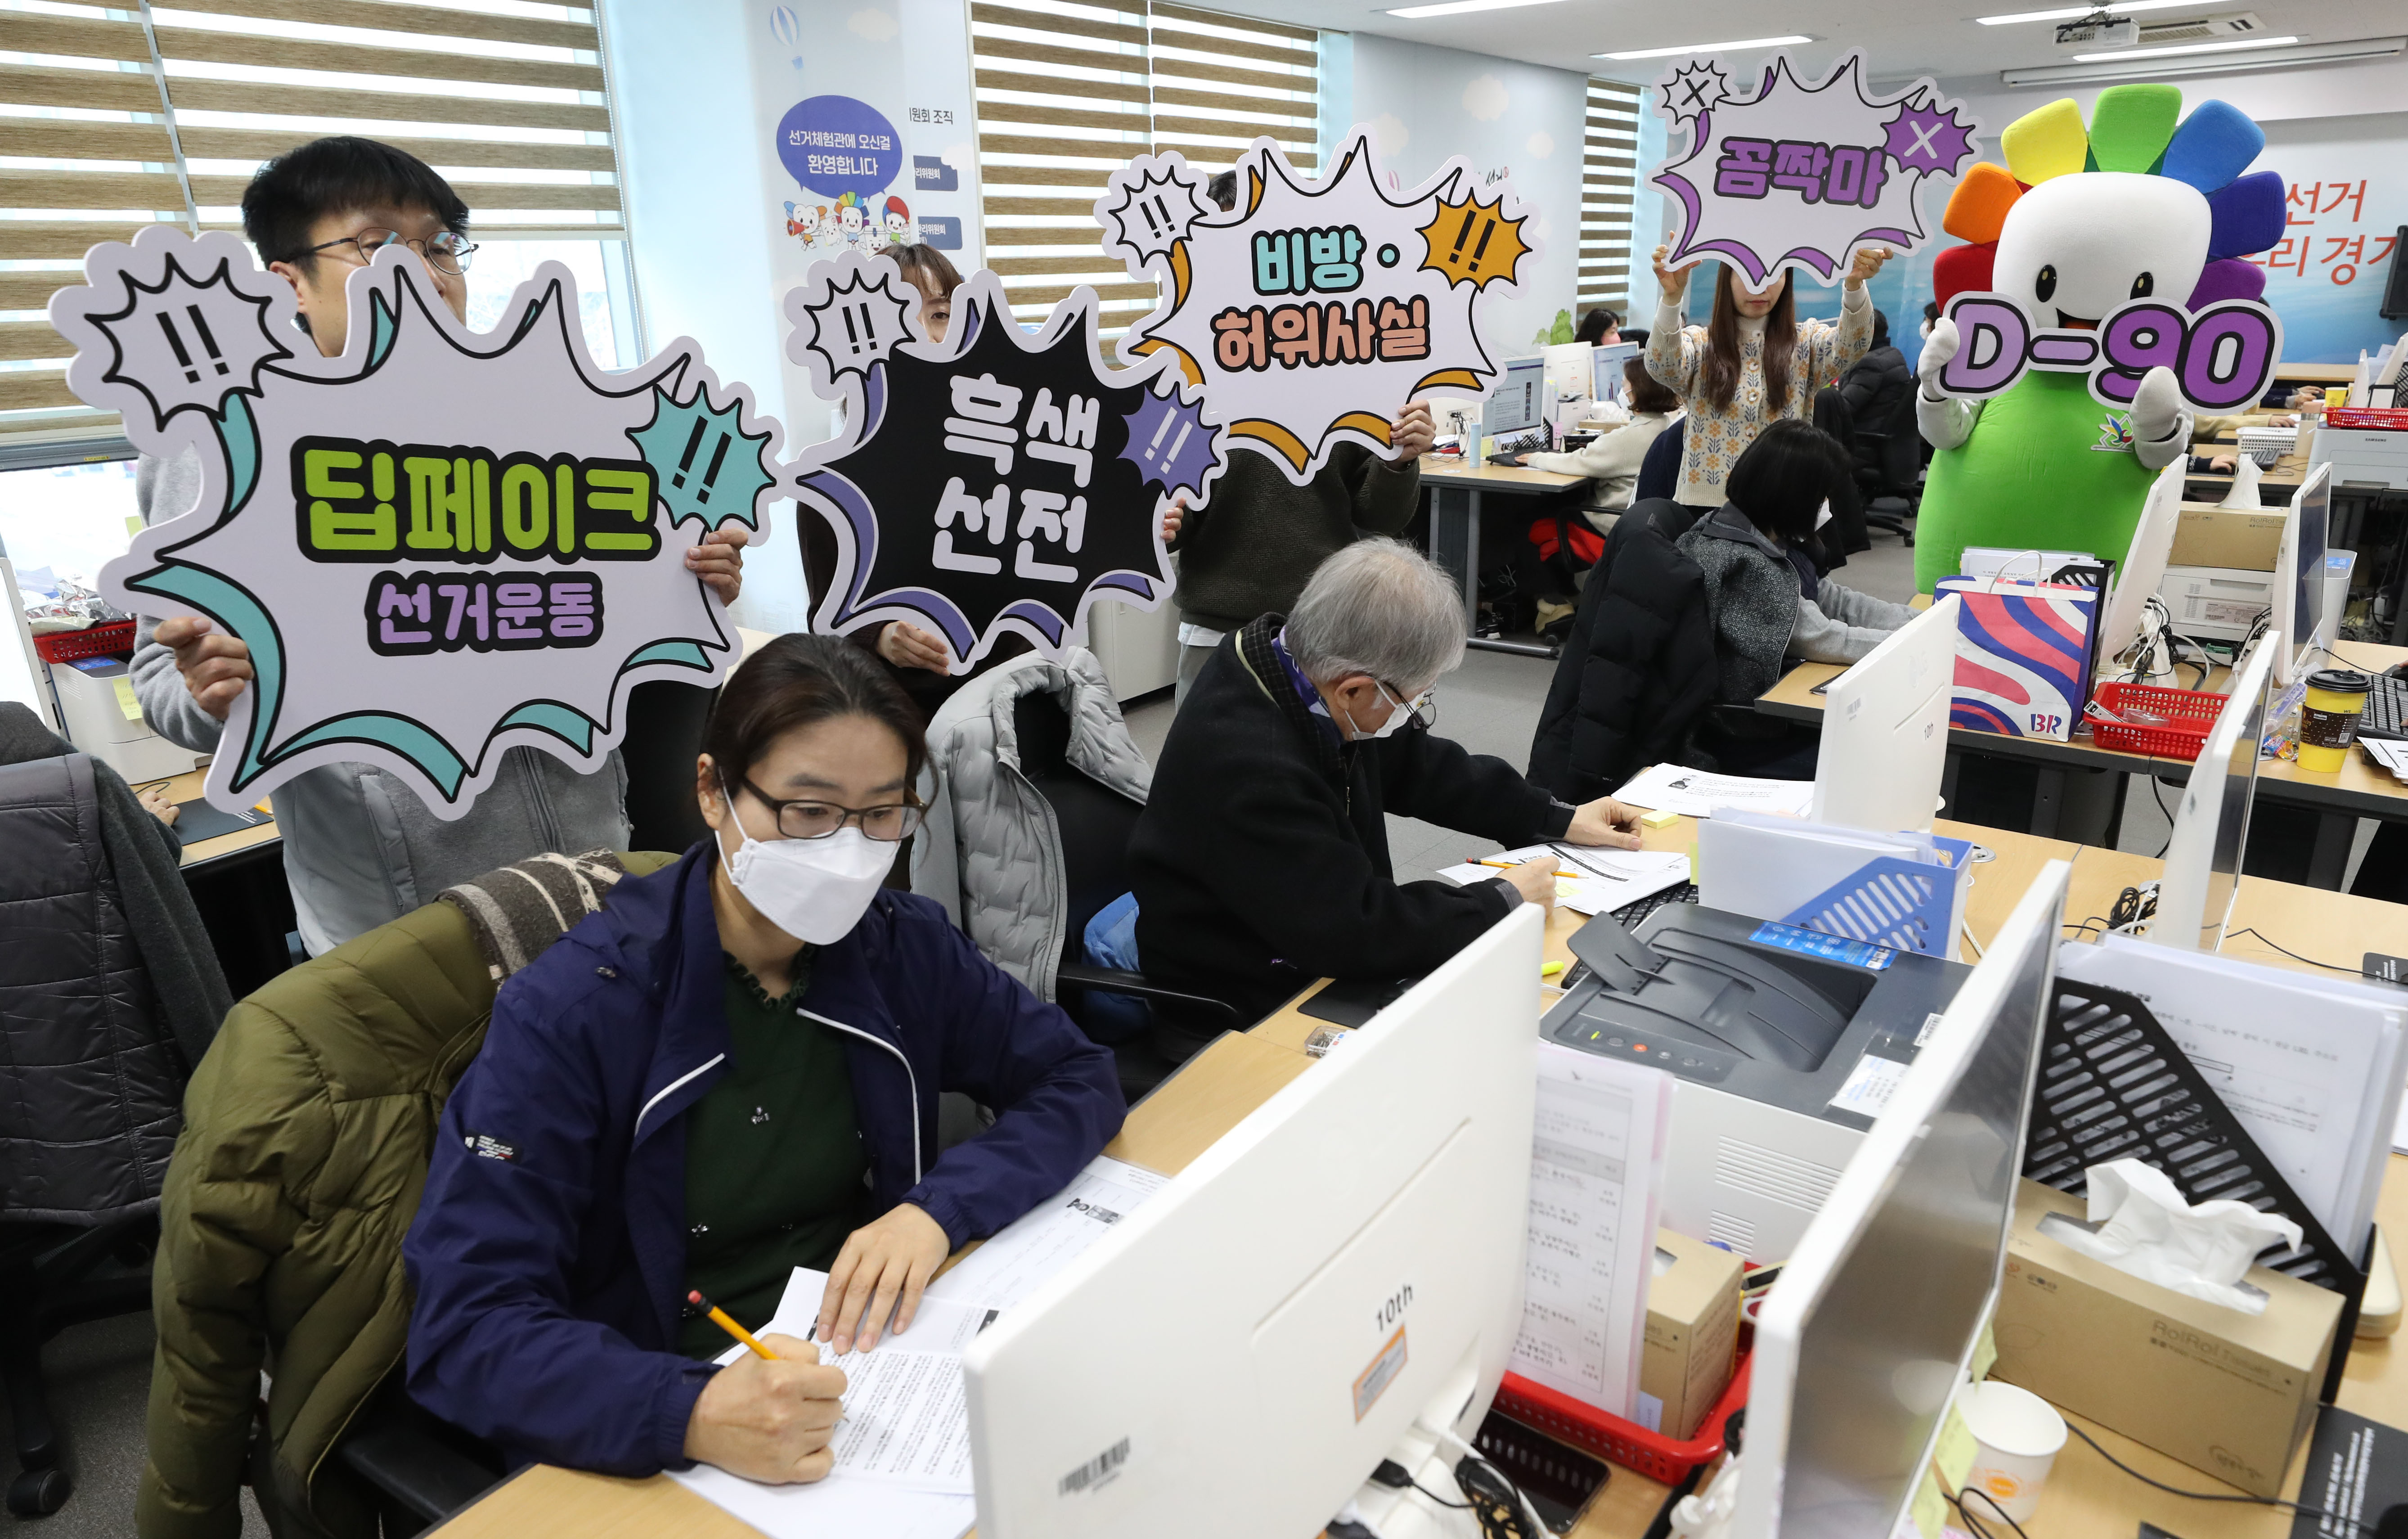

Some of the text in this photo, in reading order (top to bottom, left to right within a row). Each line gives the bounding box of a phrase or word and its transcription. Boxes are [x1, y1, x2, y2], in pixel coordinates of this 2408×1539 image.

[789, 130, 891, 150] 선거체험관에 오신걸
[909, 107, 953, 125] 원회 조직
[808, 154, 878, 176] 환영합니다
[915, 167, 940, 180] 리위원회
[1714, 136, 1889, 209] 꼼짝마
[2286, 180, 2367, 225] 선거
[2238, 236, 2310, 277] 리
[1210, 294, 1431, 373] 허위사실
[1939, 298, 2276, 410] D-90
[943, 373, 1100, 487] 흑색
[290, 435, 662, 565] 딥페이크
[932, 476, 1087, 583] 선전
[364, 570, 604, 657] 선거운동
[2030, 713, 2062, 734] BR
[1376, 1284, 1413, 1332] 10th
